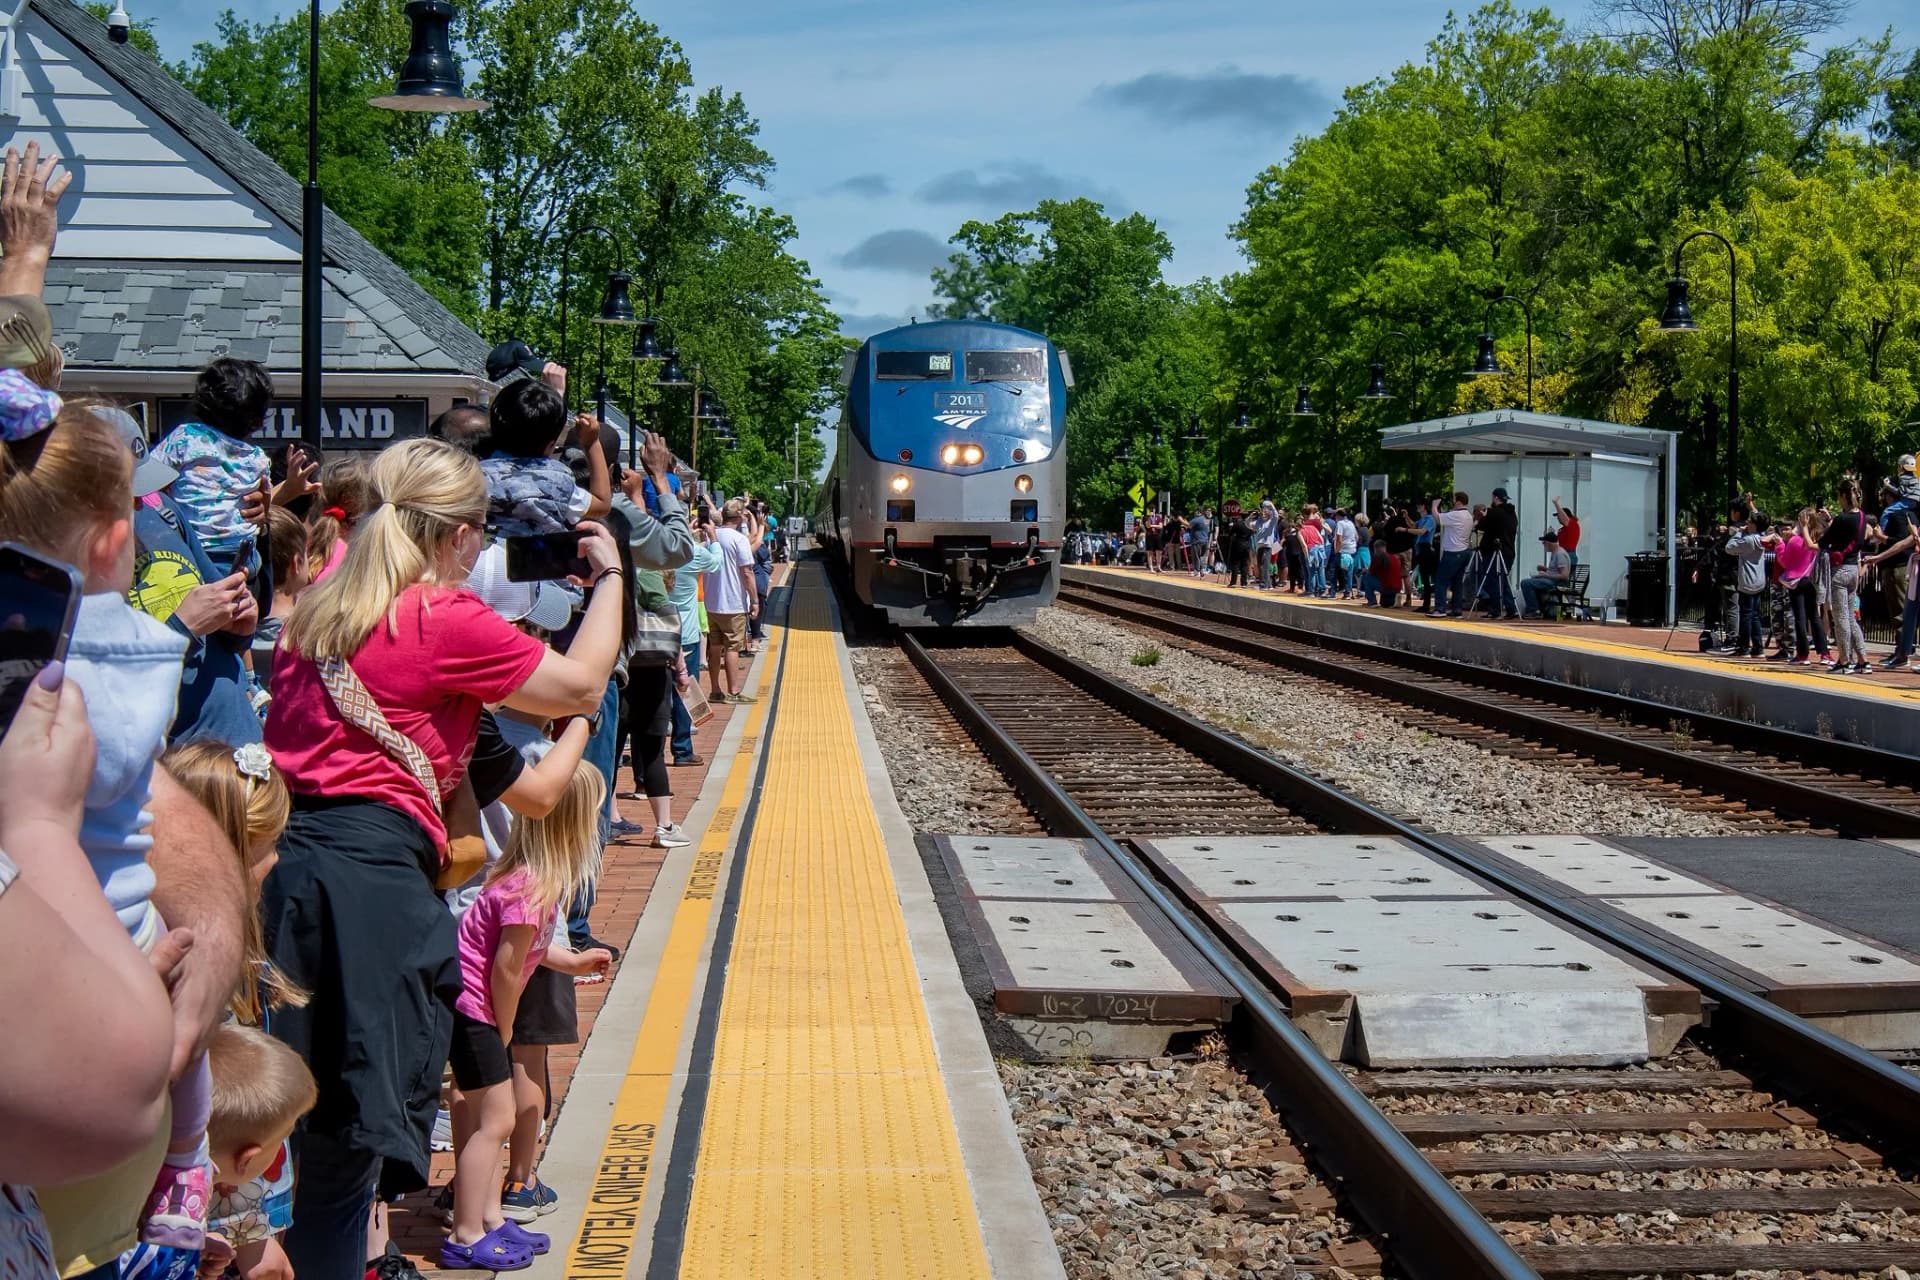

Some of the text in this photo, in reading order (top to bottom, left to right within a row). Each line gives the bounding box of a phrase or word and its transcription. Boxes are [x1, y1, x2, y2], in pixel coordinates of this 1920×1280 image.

[949, 395, 972, 406] 201
[251, 407, 394, 438] HLND
[1223, 504, 1240, 513] STOP
[608, 1123, 656, 1151] STAY
[592, 1154, 649, 1205] BEHIND
[572, 1206, 639, 1270] YELLOW
